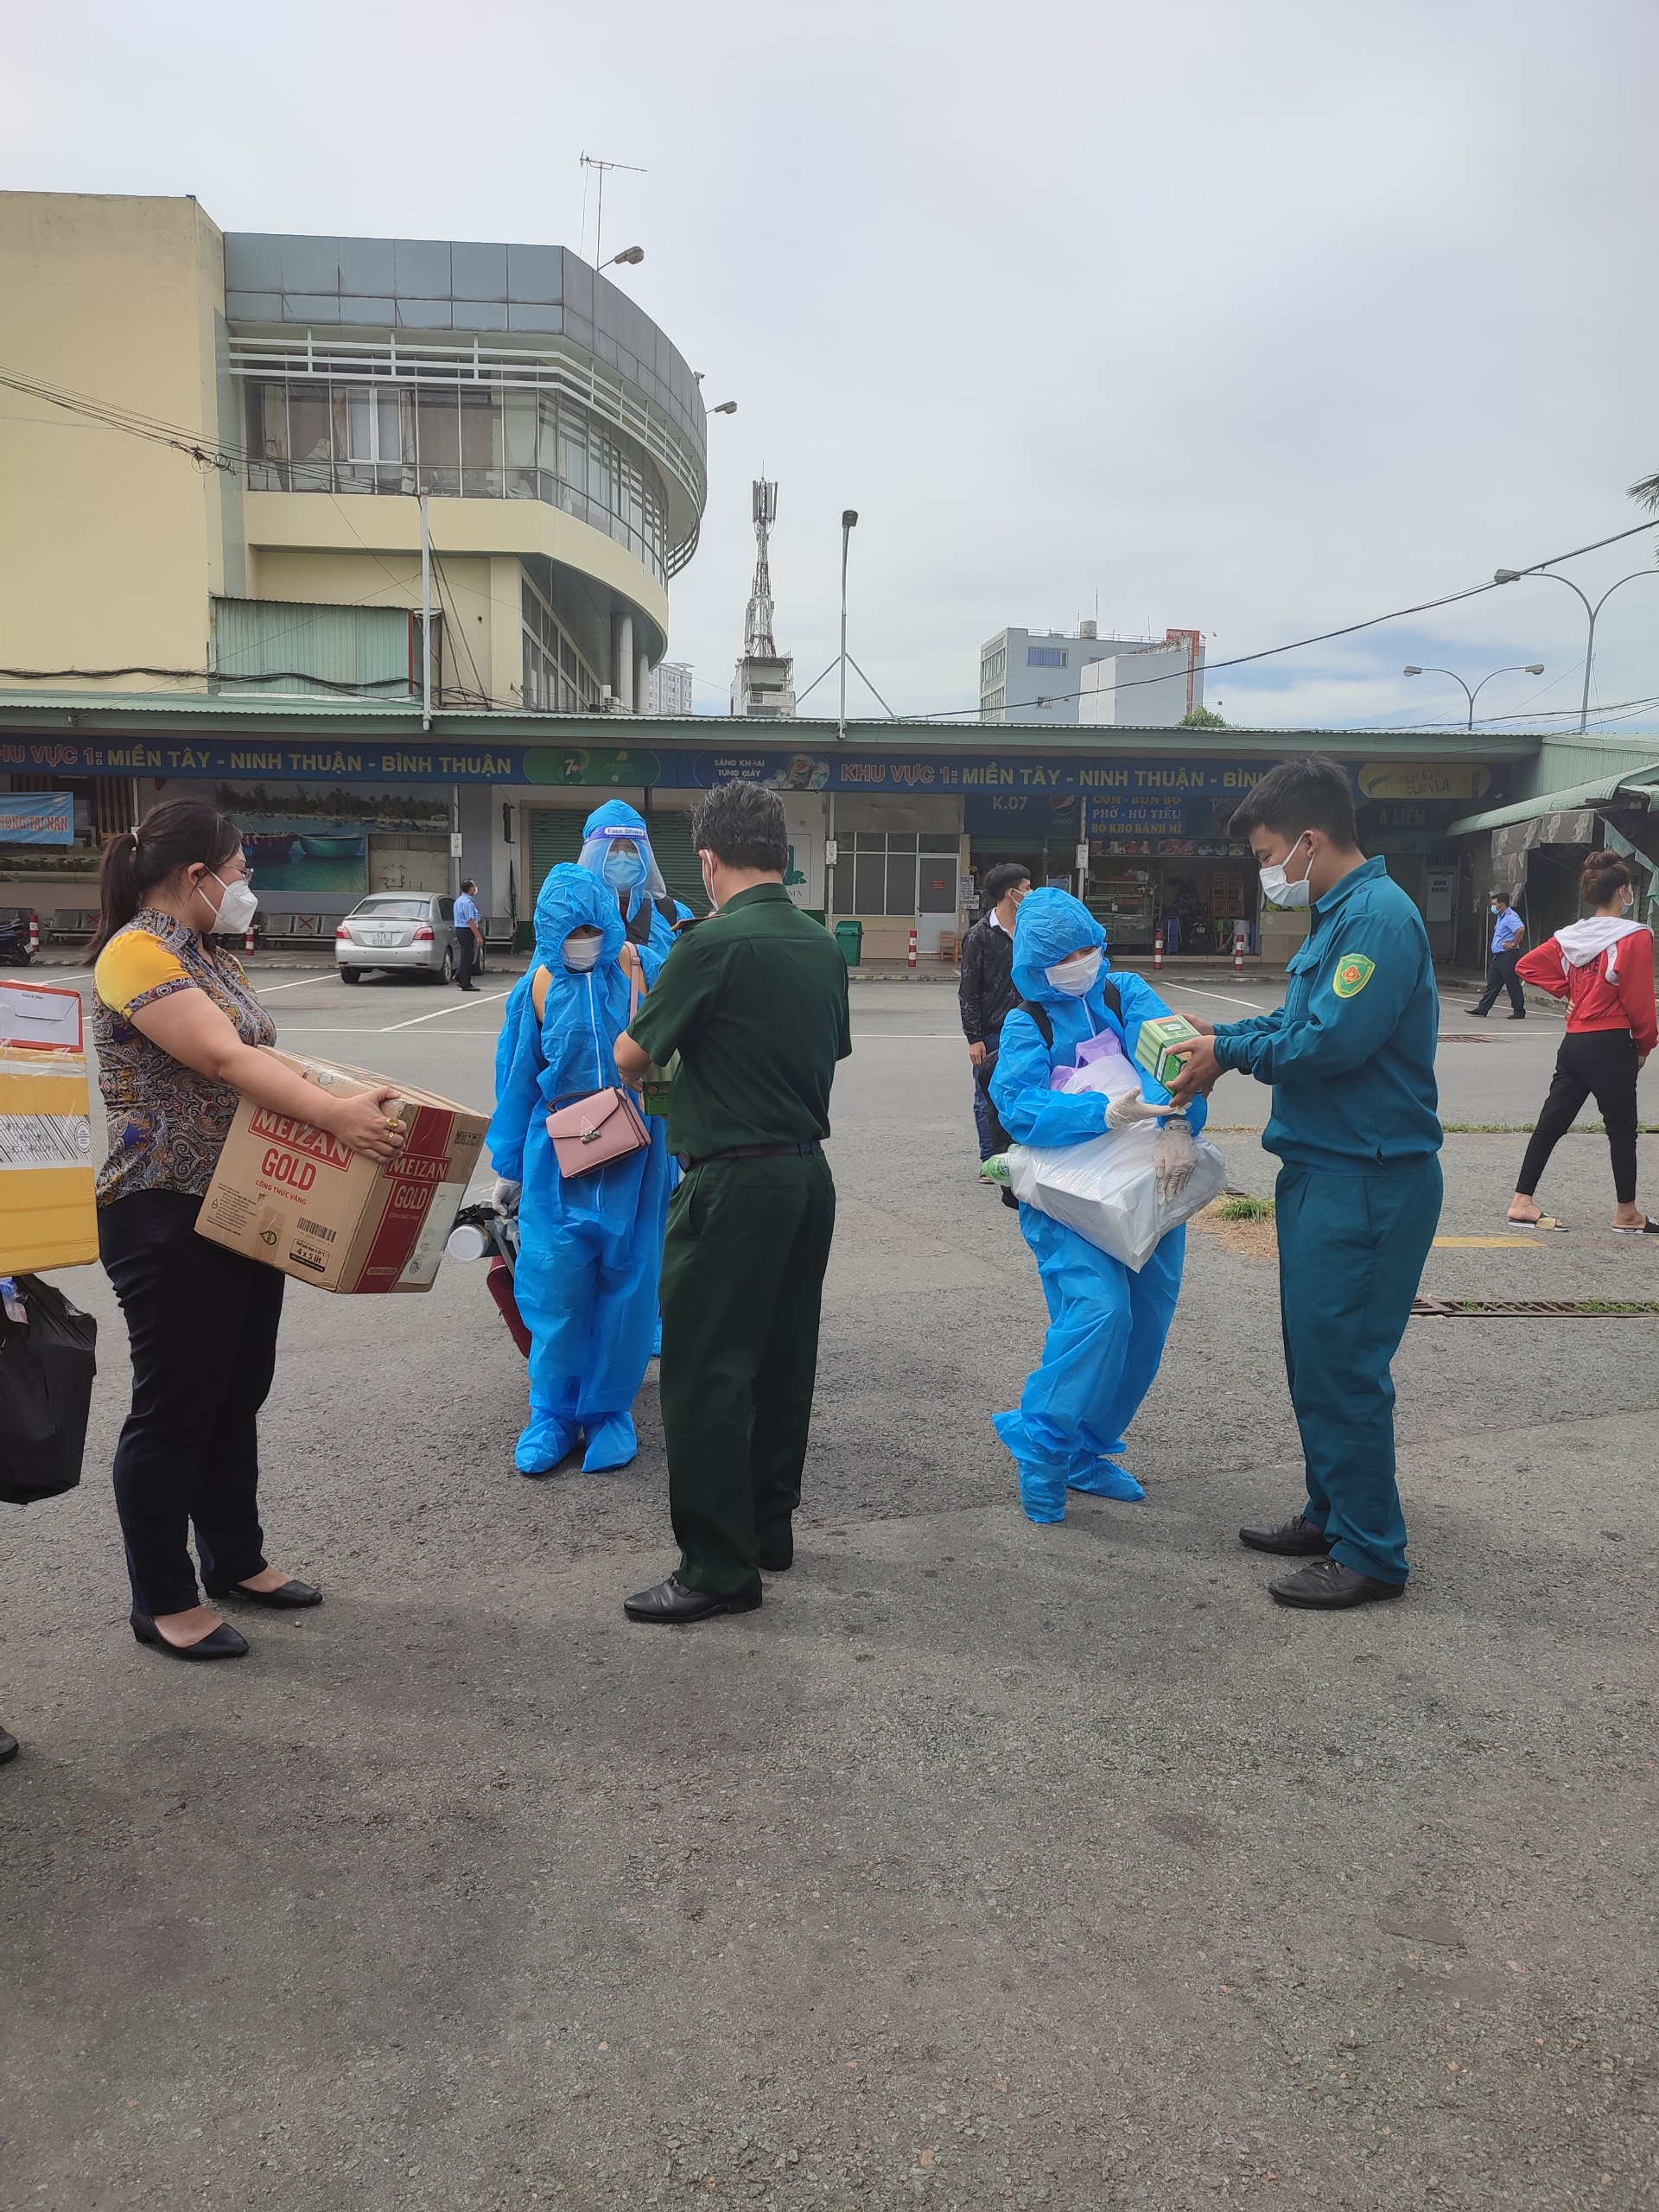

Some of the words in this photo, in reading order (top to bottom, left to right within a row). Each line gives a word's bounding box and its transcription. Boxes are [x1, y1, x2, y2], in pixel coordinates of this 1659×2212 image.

[29, 744, 78, 767] VỰC
[107, 744, 162, 767] MIỀN
[168, 747, 211, 768] TÂY
[231, 753, 283, 770] NINH
[288, 751, 362, 774] THUẬN
[381, 752, 432, 772] BÌNH
[439, 753, 512, 777] THUẬN
[841, 764, 886, 782] KHU
[891, 764, 935, 785] VỰC
[963, 761, 1014, 785] MIỀN
[1020, 766, 1061, 785] TÂY
[1079, 770, 1128, 786] NINH
[1135, 767, 1205, 790] THUẬN
[993, 796, 1028, 810] K.07
[1092, 805, 1119, 818] PHỞ
[1052, 817, 1075, 826] pepsi
[1109, 823, 1133, 833] KHO
[1135, 821, 1166, 834] BÁNH
[254, 1109, 350, 1164] MEIZAN
[261, 1147, 317, 1192] GOLD
[388, 1158, 448, 1180] MEIZAN
[255, 1179, 273, 1191] CÔNG
[272, 1186, 290, 1198] THỨC
[289, 1193, 307, 1205] VÀNG
[394, 1185, 428, 1210] GOLD
